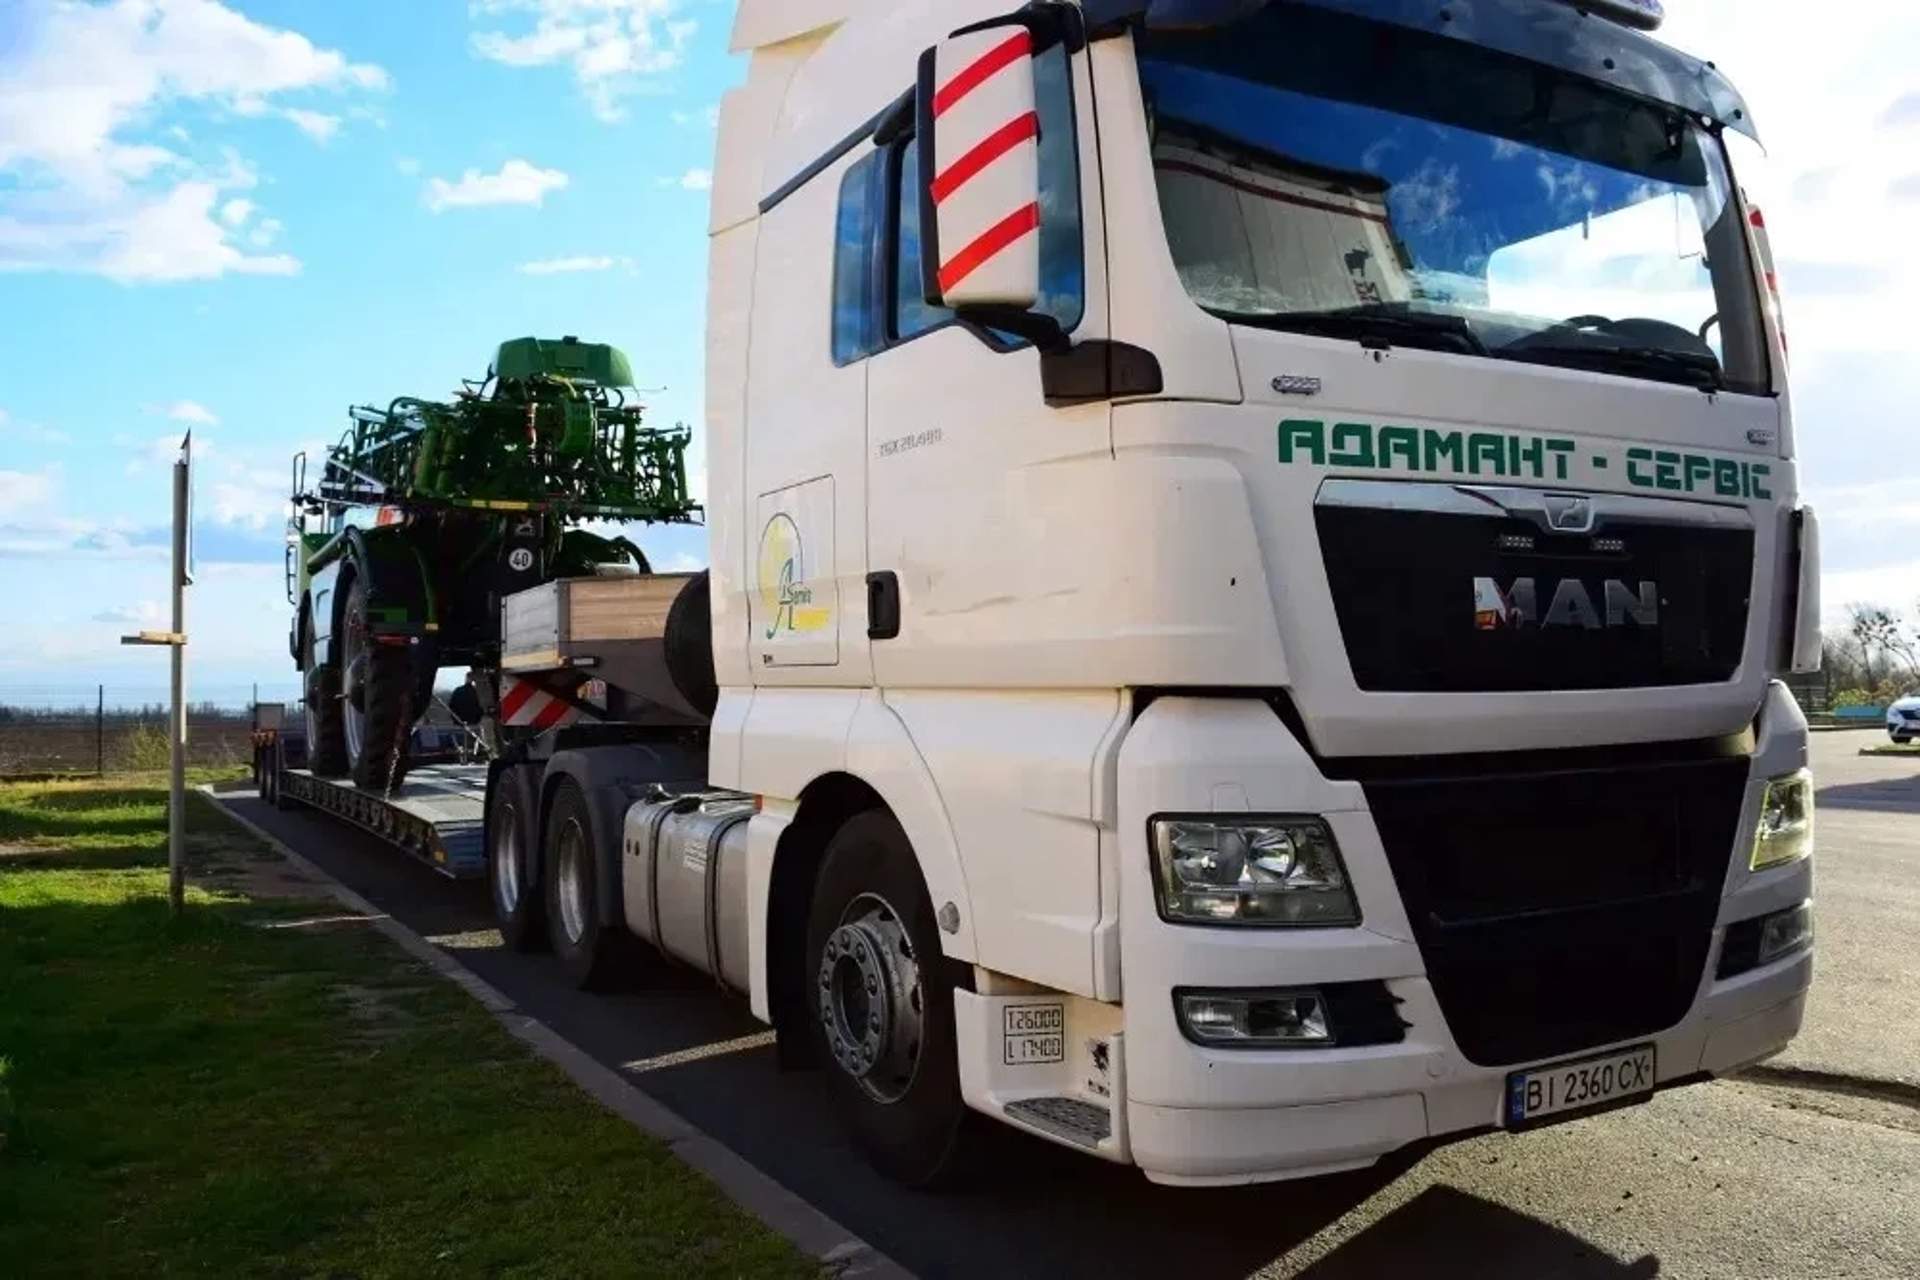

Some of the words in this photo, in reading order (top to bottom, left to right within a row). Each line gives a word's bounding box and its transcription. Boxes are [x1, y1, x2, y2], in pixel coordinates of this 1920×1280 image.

[1277, 419, 1575, 480] АДАМАНТ
[512, 551, 529, 567] 40
[1473, 576, 1658, 630] MAN
[1564, 1064, 1614, 1104] 2360
[1618, 1055, 1646, 1089] CX
